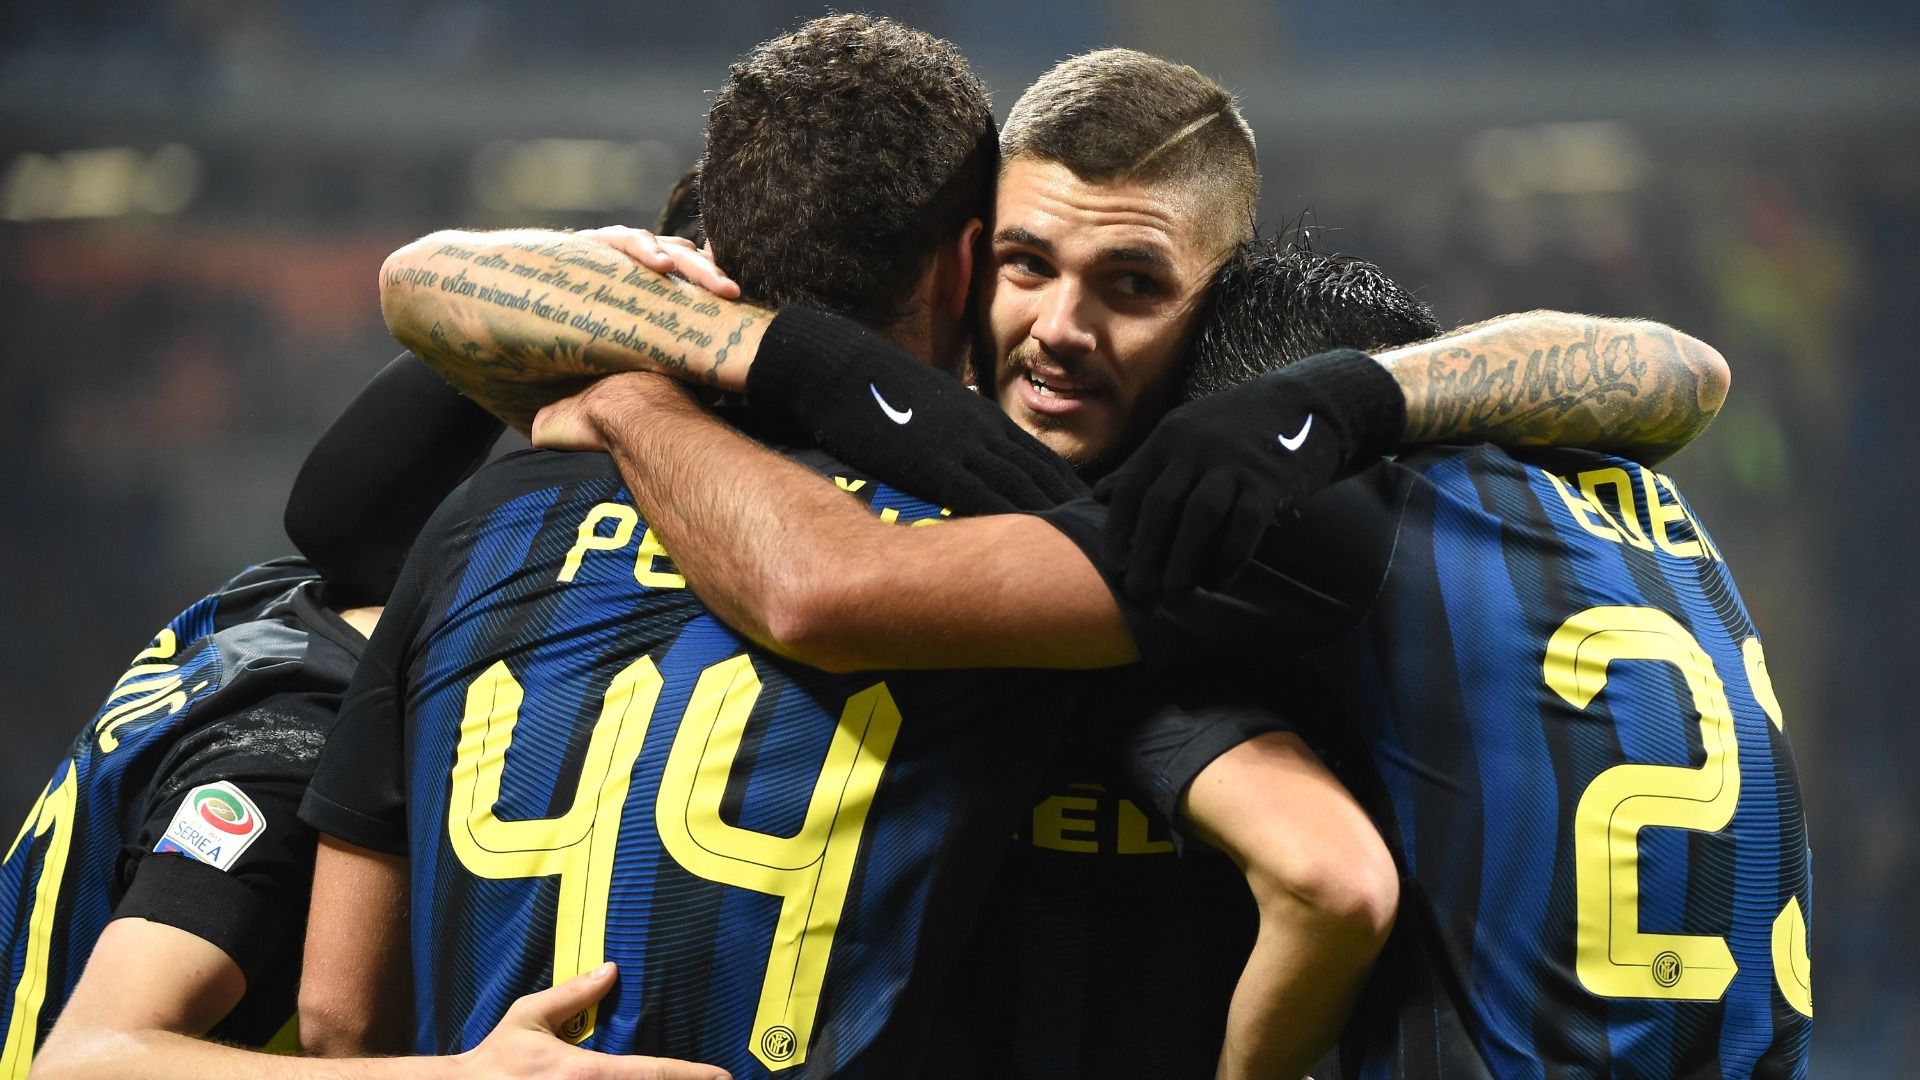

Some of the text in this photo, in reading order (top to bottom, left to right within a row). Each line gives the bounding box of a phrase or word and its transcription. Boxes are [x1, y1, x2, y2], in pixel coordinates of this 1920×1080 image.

[569, 310, 612, 346] abajo
[608, 324, 648, 354] sobre
[648, 344, 698, 376] nosot
[174, 820, 212, 853] SERIE
[206, 845, 222, 862] A
[448, 654, 903, 1072] 44
